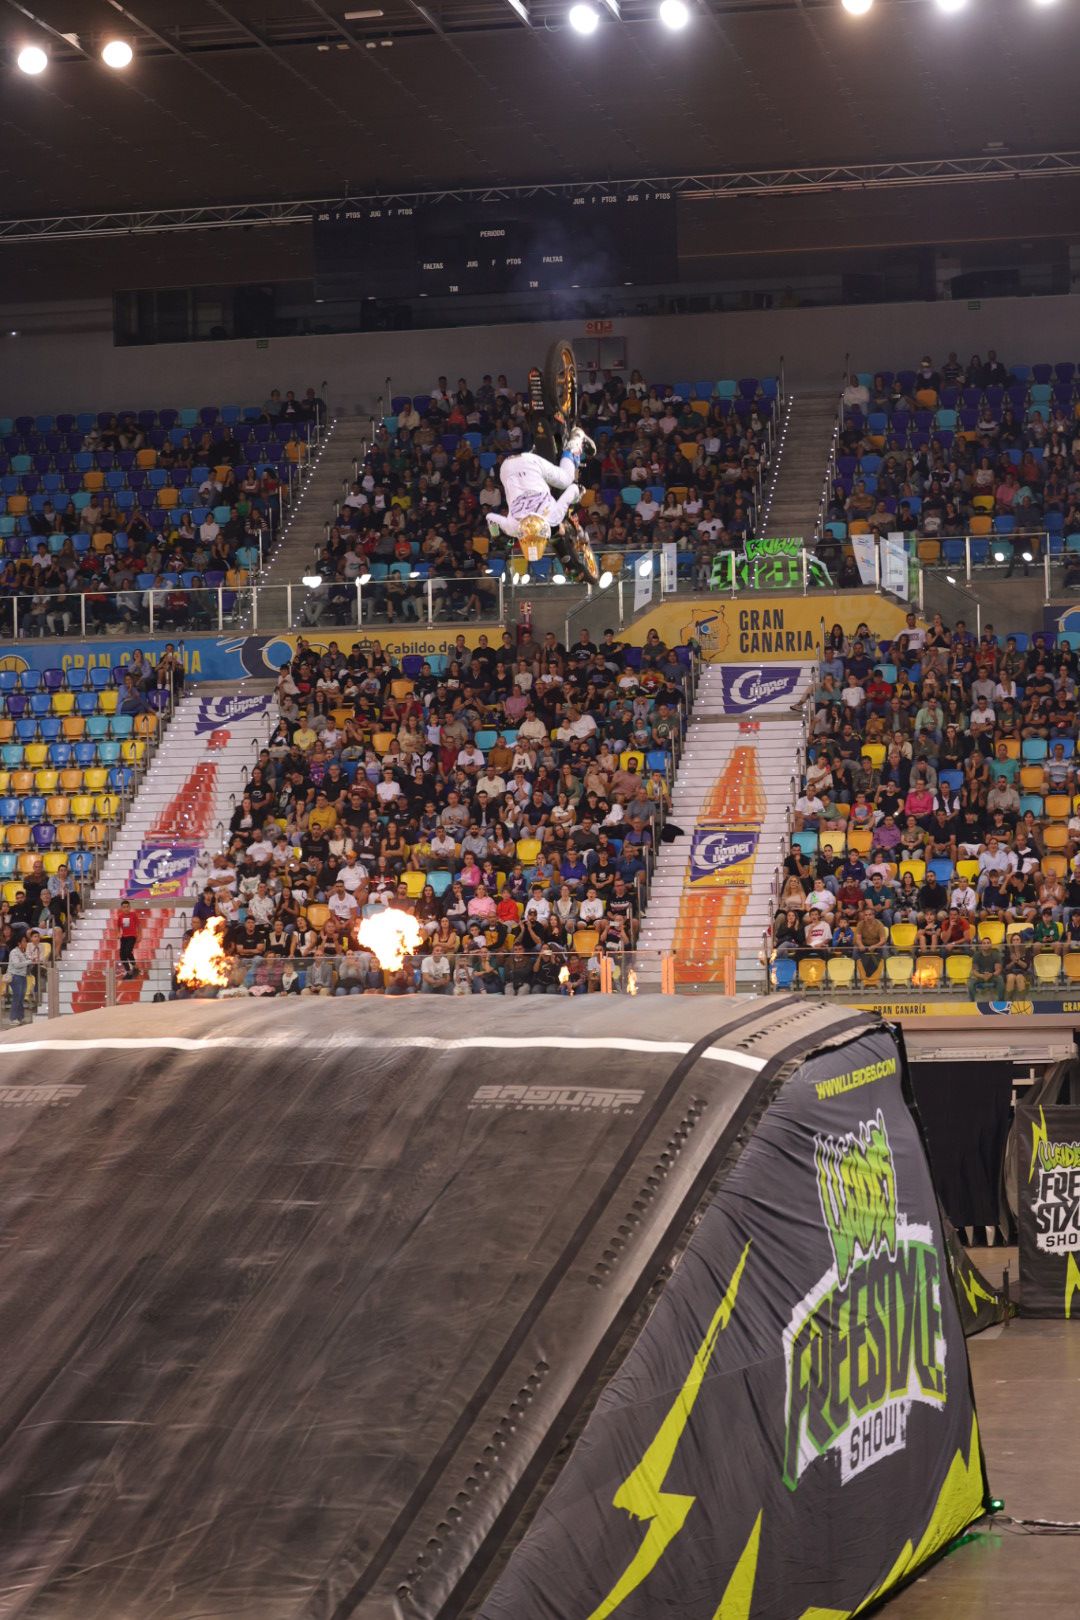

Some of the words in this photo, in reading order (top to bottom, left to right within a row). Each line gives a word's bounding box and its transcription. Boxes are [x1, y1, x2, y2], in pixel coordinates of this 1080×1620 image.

[573, 197, 585, 205] JUG
[739, 609, 785, 632] GRAN
[385, 642, 436, 654] Cabildo
[740, 631, 814, 653] CANARIA
[62, 653, 111, 671] GRAN
[730, 670, 790, 705] Clipper
[205, 695, 266, 722] Clipper
[693, 832, 753, 870] Clipper
[473, 1085, 646, 1108] BAGJUMP
[467, 1104, 634, 1115] WWW.BAGJUMP.COM
[850, 1403, 898, 1470] SHOW
